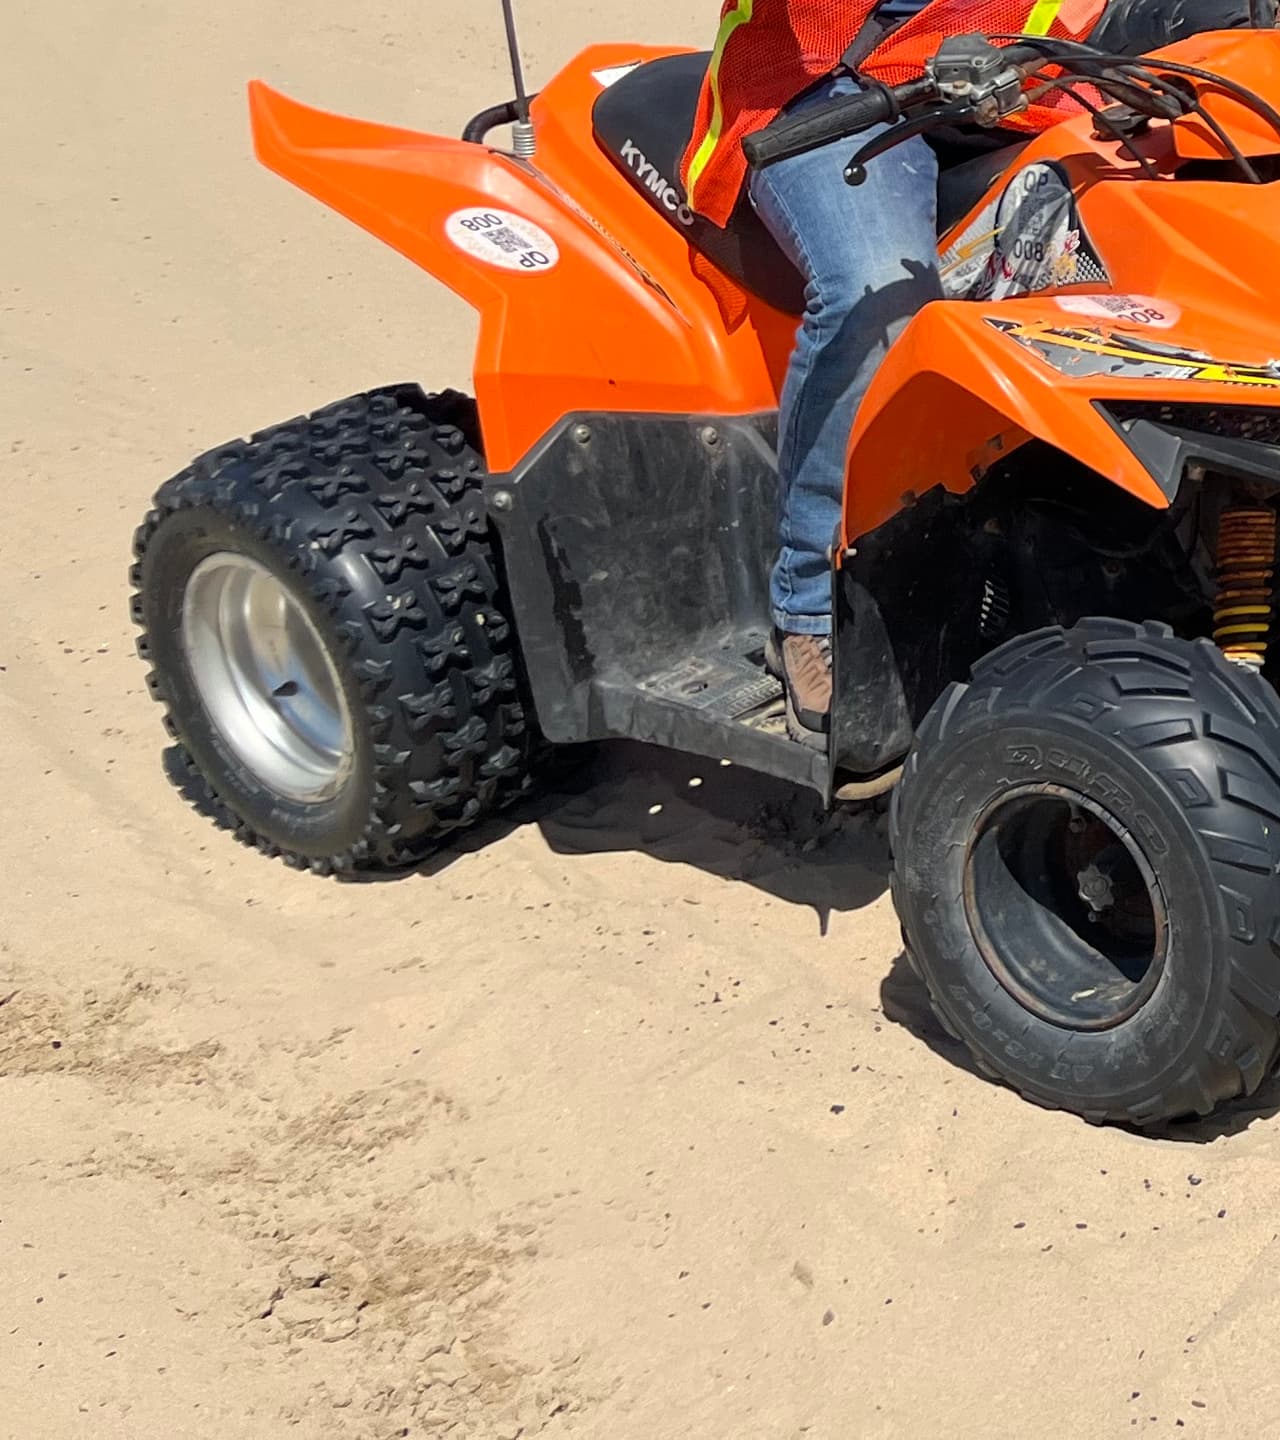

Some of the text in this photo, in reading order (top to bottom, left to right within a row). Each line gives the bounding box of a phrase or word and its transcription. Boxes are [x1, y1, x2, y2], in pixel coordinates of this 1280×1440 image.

[620, 139, 694, 226] KYMCO
[1023, 170, 1048, 192] OP
[460, 213, 503, 231] 008
[519, 251, 550, 268] OP
[1014, 239, 1044, 262] 008
